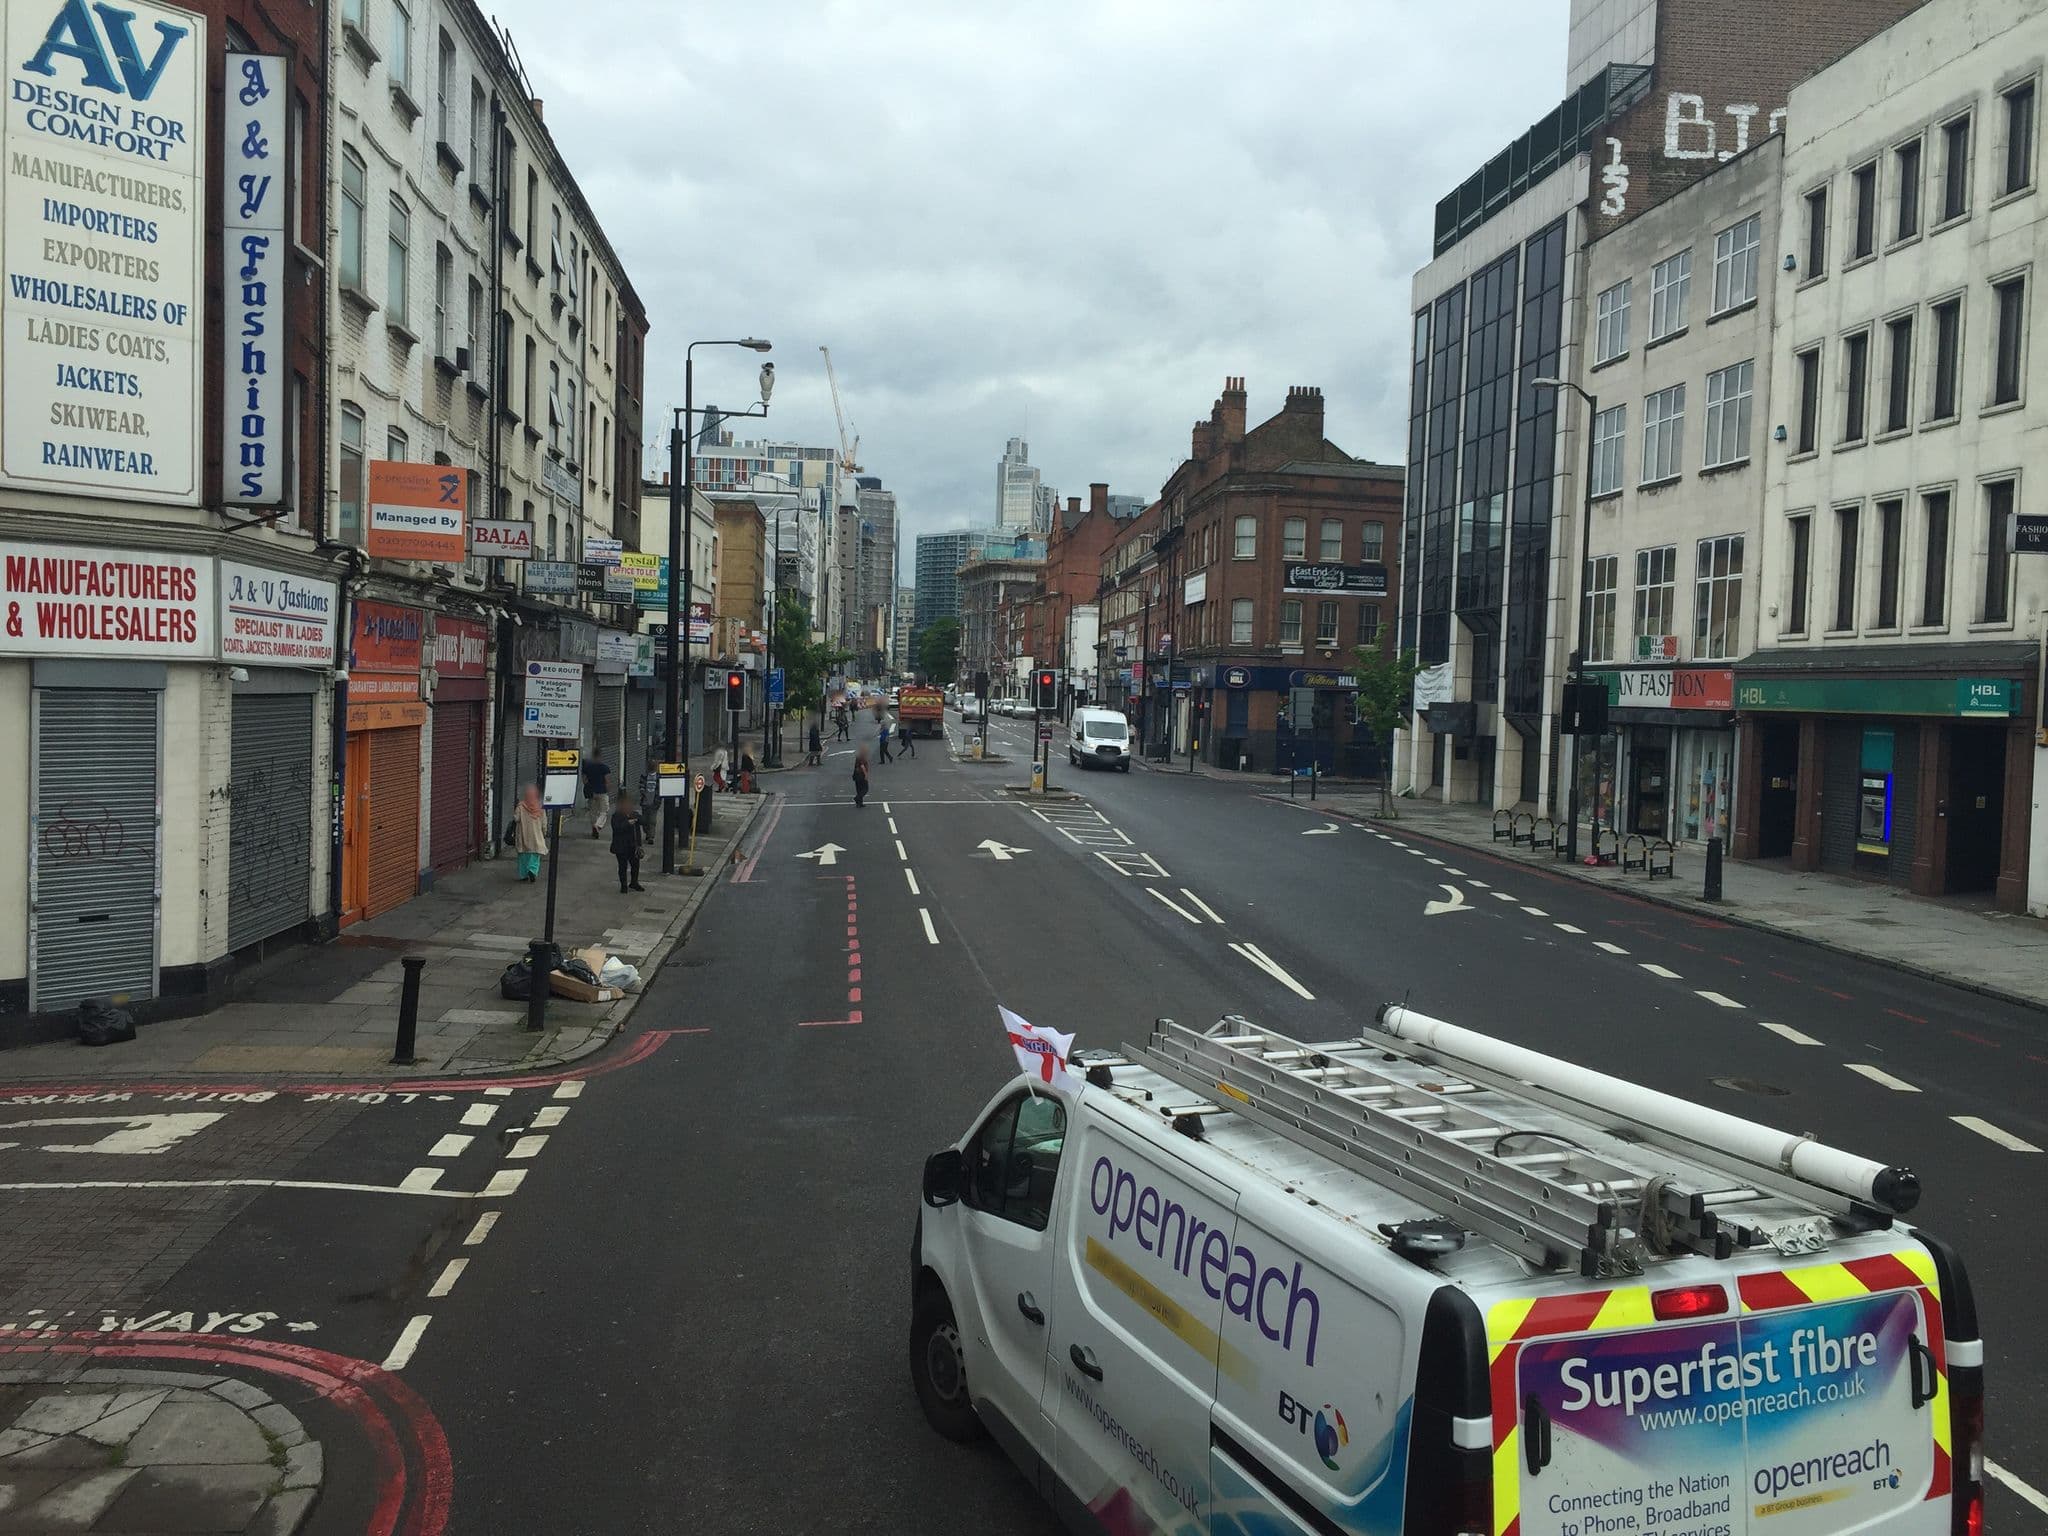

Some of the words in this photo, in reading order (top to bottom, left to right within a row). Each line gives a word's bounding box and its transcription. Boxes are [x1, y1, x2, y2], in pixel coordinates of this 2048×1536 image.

[22, 0, 188, 101] AV
[239, 59, 270, 107] A
[12, 78, 120, 126] DESIGN
[131, 110, 186, 144] FOR
[26, 108, 174, 162] COMFORT
[241, 119, 269, 160] &
[11, 151, 187, 214] MANUFACTURERS,
[238, 174, 271, 220] V
[43, 198, 158, 244] IMPORTERS
[43, 238, 160, 283] EXPORTERS
[10, 274, 157, 325] WHOLESALERS
[163, 301, 188, 326] OF
[27, 317, 99, 352] LADIES
[105, 333, 170, 364] COATS,
[56, 363, 143, 399] JACKETS,
[239, 235, 269, 498] Fashions
[50, 402, 150, 438] SKIWEAR,
[42, 440, 158, 476] RAINWEAR.
[376, 511, 436, 525] Managed
[441, 516, 458, 528] By
[474, 527, 530, 546] BALA
[2029, 533, 2040, 543] UK
[6, 556, 197, 602] MANUFACTURERS
[613, 567, 634, 576] OFFICE
[636, 568, 645, 576] TO
[646, 568, 657, 577] LET
[624, 555, 657, 567] rystal
[1295, 566, 1311, 576] East
[1312, 567, 1328, 576] End
[228, 575, 243, 601] A
[247, 578, 257, 600] &
[278, 580, 329, 613] Fashions
[6, 601, 23, 637] &
[36, 602, 197, 643] WHOLESALERS
[234, 617, 283, 638] SPECIALIST
[285, 623, 294, 639] IN
[296, 625, 323, 642] LADIES
[223, 637, 245, 655] COATS,
[273, 642, 303, 658] RAINWEAR
[308, 645, 333, 660] SKIWEAR
[1230, 676, 1243, 684] HILL
[1338, 675, 1358, 687] HILL
[1640, 673, 1706, 697] FASHION
[1740, 687, 1767, 705] HBL
[1971, 684, 2001, 696] HBL
[526, 700, 546, 708] Except
[548, 701, 579, 709] 10am-4pm
[1091, 1156, 1320, 1367] openreach
[1560, 1341, 1779, 1416] Superfast
[1790, 1325, 1877, 1379] fibre
[1279, 1390, 1313, 1434] BT
[1640, 1376, 1865, 1432] www.openreach.co.uk
[1065, 1372, 1201, 1520] www.openreach.co.uk
[1754, 1439, 1890, 1497] openreach
[1873, 1478, 1887, 1490] BT
[1549, 1488, 1643, 1514] Connecting
[1648, 1480, 1674, 1499] the
[1679, 1473, 1730, 1495] Nation
[1775, 1501, 1795, 1512] Group
[1796, 1496, 1823, 1507] business
[1561, 1520, 1579, 1536] to
[1584, 1512, 1641, 1534] Phone,
[1646, 1494, 1730, 1526] Broadband
